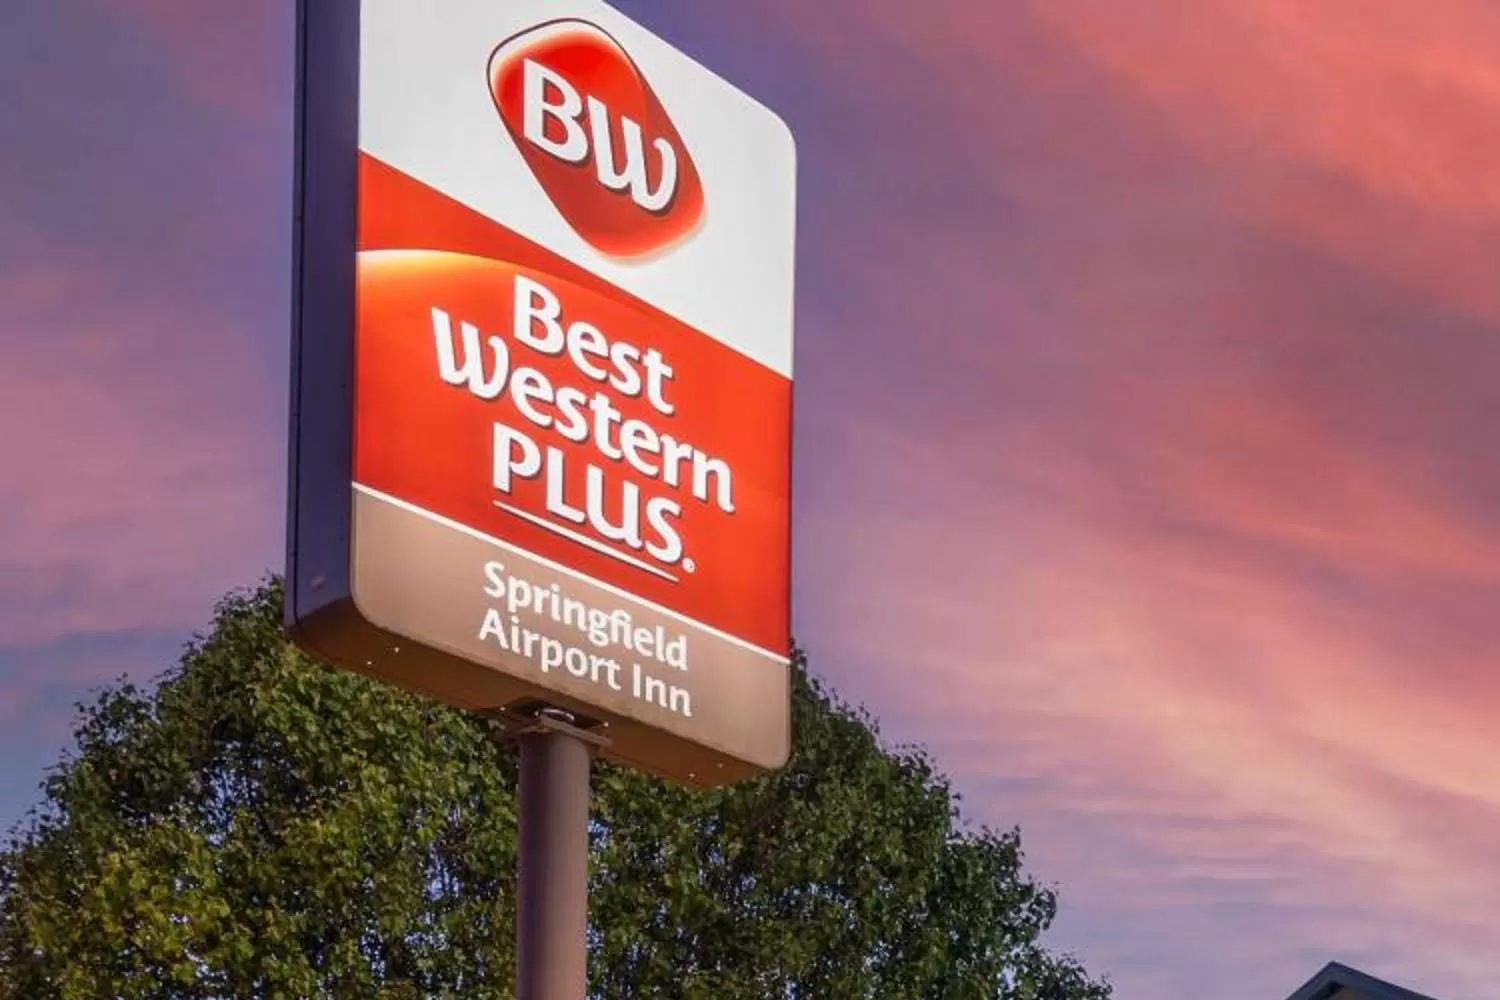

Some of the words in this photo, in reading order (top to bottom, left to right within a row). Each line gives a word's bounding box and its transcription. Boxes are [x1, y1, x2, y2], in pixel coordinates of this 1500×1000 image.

[524, 58, 677, 211] BW
[431, 306, 734, 512] Western
[514, 274, 675, 414] Best
[479, 609, 622, 691] Airport
[632, 664, 692, 717] Inn
[484, 560, 688, 671] Springfield
